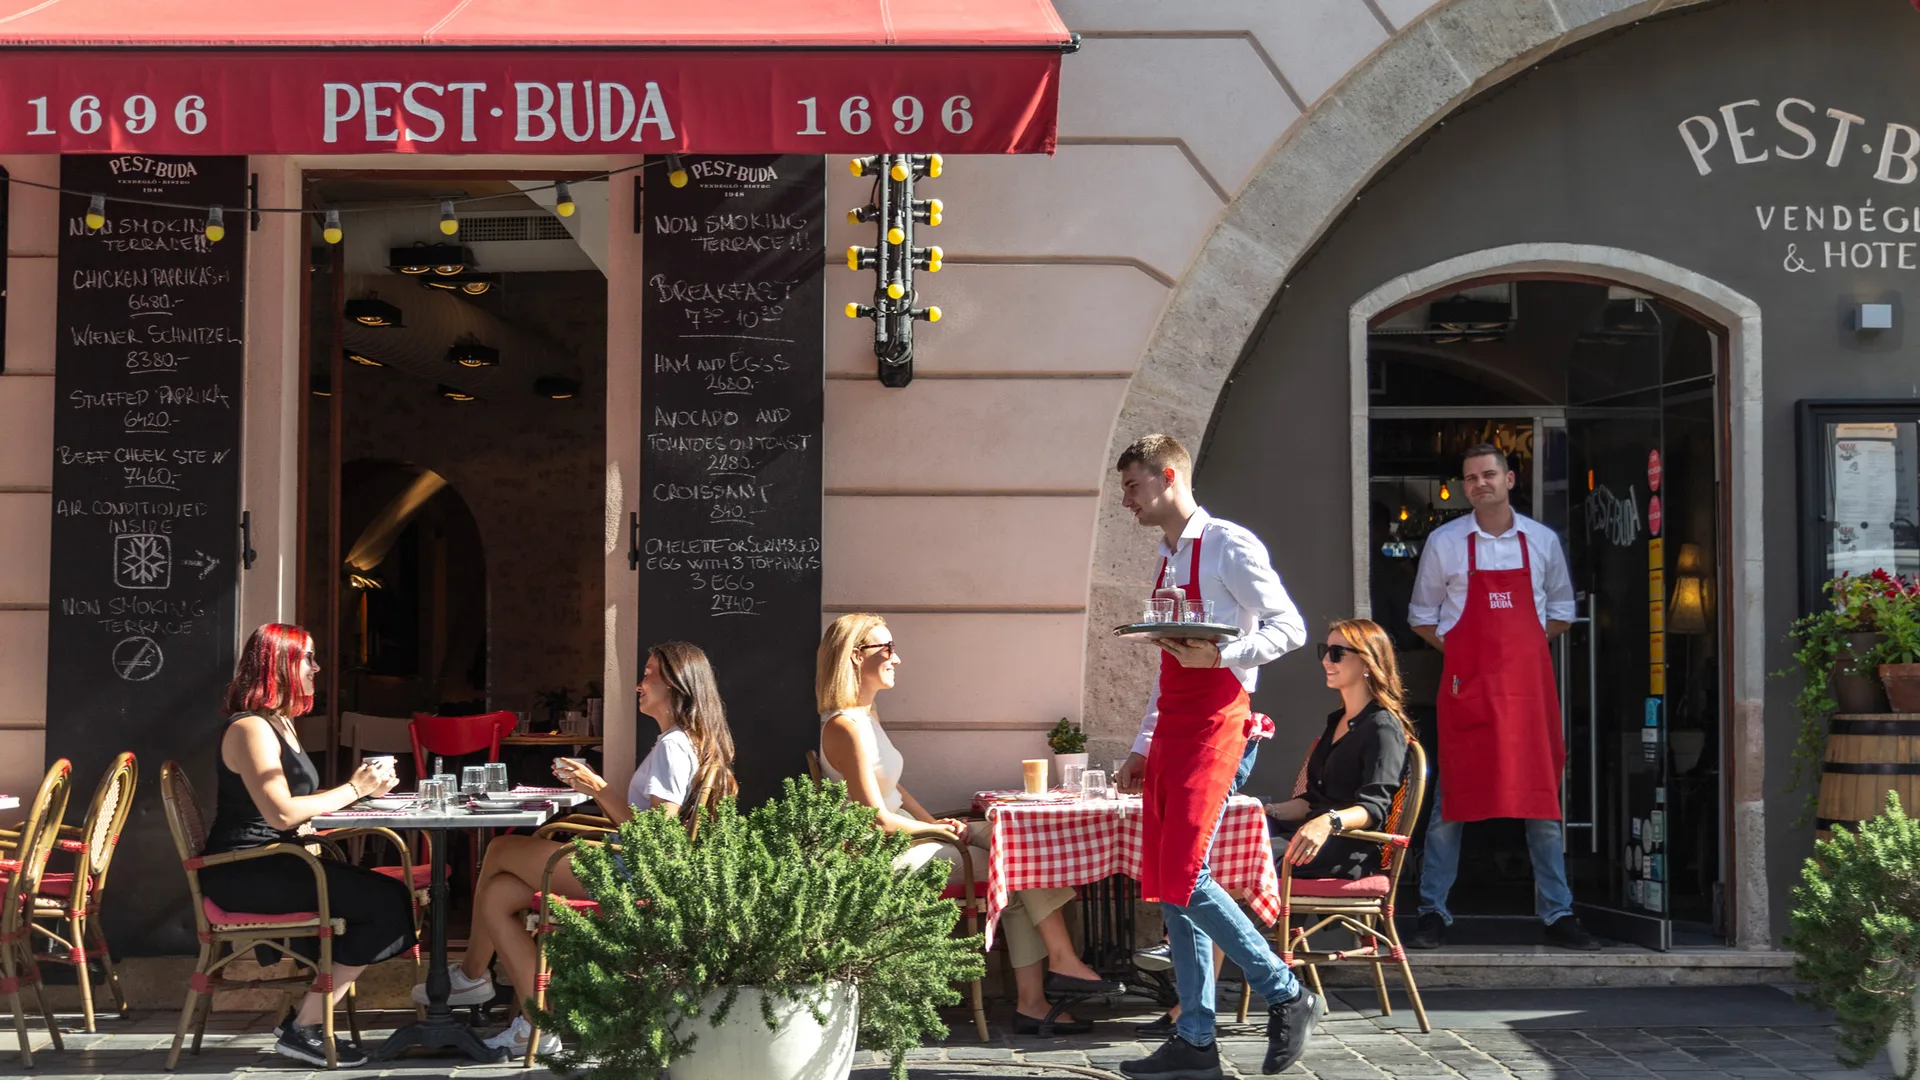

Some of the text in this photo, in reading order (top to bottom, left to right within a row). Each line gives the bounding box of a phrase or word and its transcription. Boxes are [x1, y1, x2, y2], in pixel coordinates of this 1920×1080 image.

[26, 94, 208, 136] 1696
[796, 94, 975, 136] 1696
[654, 213, 807, 234] NON SMOKING
[1782, 242, 1817, 273] &
[73, 269, 148, 289] CHICKEN
[649, 274, 799, 303] BREAKFAST
[71, 324, 242, 345] WIENER SCHNITZEL
[653, 353, 691, 374] HAM
[729, 351, 791, 372] EGGS
[69, 384, 230, 409] STUFFED PAPRIKA
[655, 406, 792, 427] AVOCADO AND
[647, 432, 812, 451] TOMATOES ON TOAST
[57, 445, 111, 465] BEEF
[114, 448, 169, 463] CHEEK
[653, 483, 773, 503] CROISSANT
[56, 500, 208, 517] AIR CONDITIONED
[109, 518, 173, 534] INSIDE
[645, 538, 730, 555] OMELETTE
[728, 542, 748, 552] OR
[646, 555, 820, 573] EGG WITH 3 TOPPINGS
[690, 572, 754, 591] 3 EGG
[1488, 591, 1511, 601] PEST
[1490, 599, 1513, 609] BUDA
[62, 596, 205, 617] NON SMOKING
[99, 619, 193, 635] TERRACE
